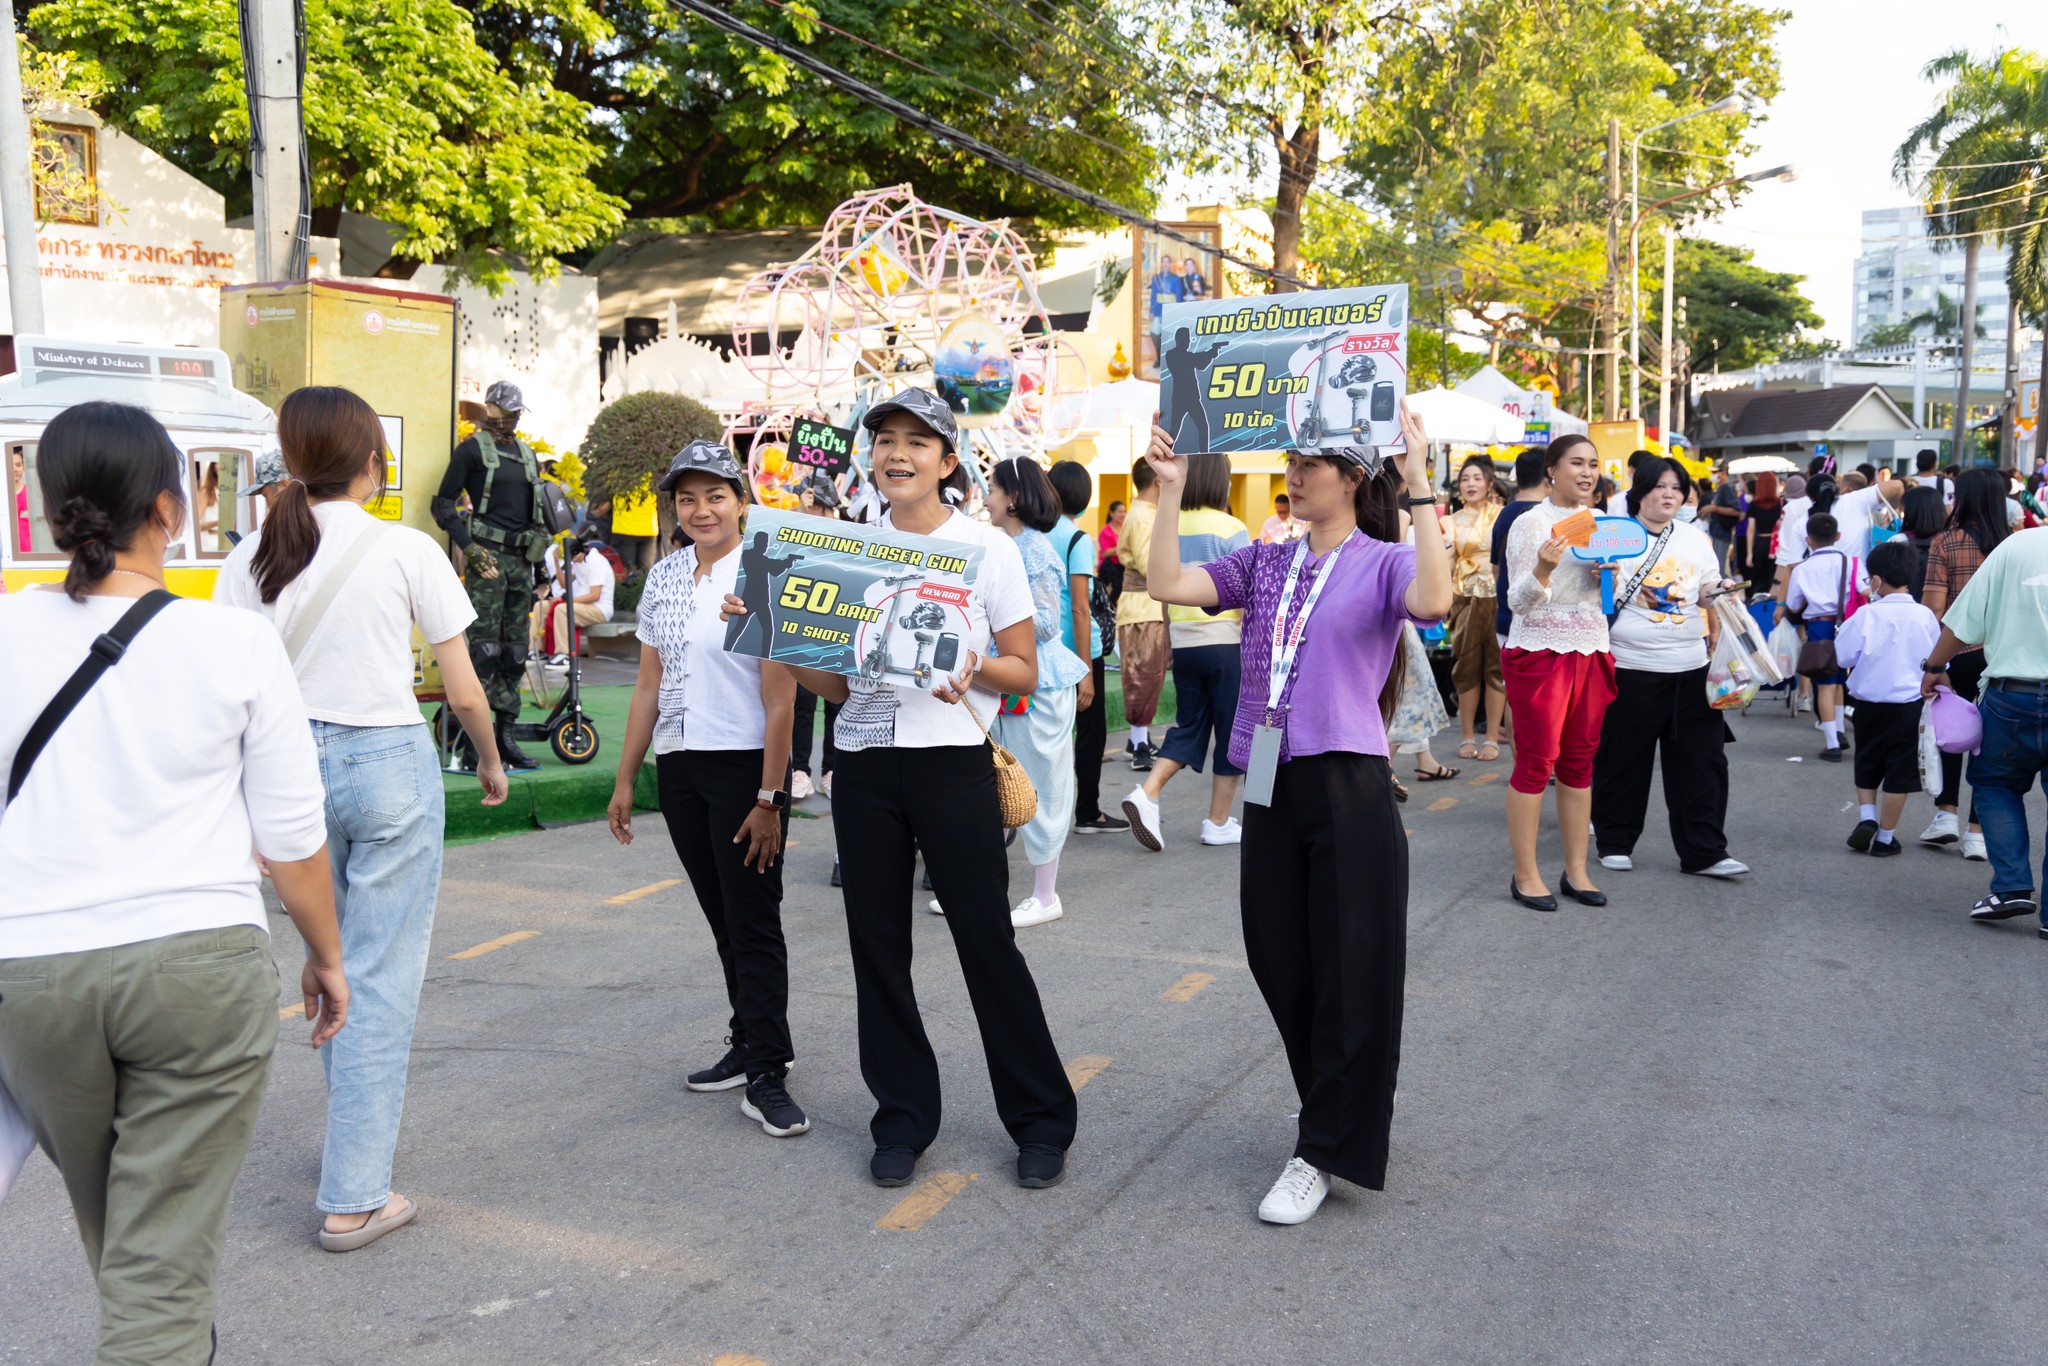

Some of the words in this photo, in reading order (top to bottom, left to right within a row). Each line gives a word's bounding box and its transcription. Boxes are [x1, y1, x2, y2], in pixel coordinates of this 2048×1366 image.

[37, 235, 234, 269] ดกระทรวงกลาโหม
[1347, 336, 1393, 351] รางวัล
[38, 352, 84, 366] Ministry
[87, 355, 97, 366] of
[103, 357, 144, 368] Defence
[1208, 363, 1266, 400] 50
[1266, 376, 1309, 395] บาท
[1223, 411, 1245, 429] 10
[1247, 410, 1274, 429] นัด
[797, 423, 847, 454] ยิงปืน
[776, 526, 864, 556] SHOOTING
[866, 543, 924, 566] LASER
[926, 554, 967, 574] GUN
[1606, 537, 1620, 548] 100
[779, 575, 841, 617] 50
[834, 602, 885, 624] BAHT
[922, 587, 961, 601] REWARD
[781, 620, 797, 634] 10
[802, 625, 851, 645] SHOTS
[1275, 615, 1285, 647] CHAISERI
[1289, 616, 1305, 648] CHAISERI
